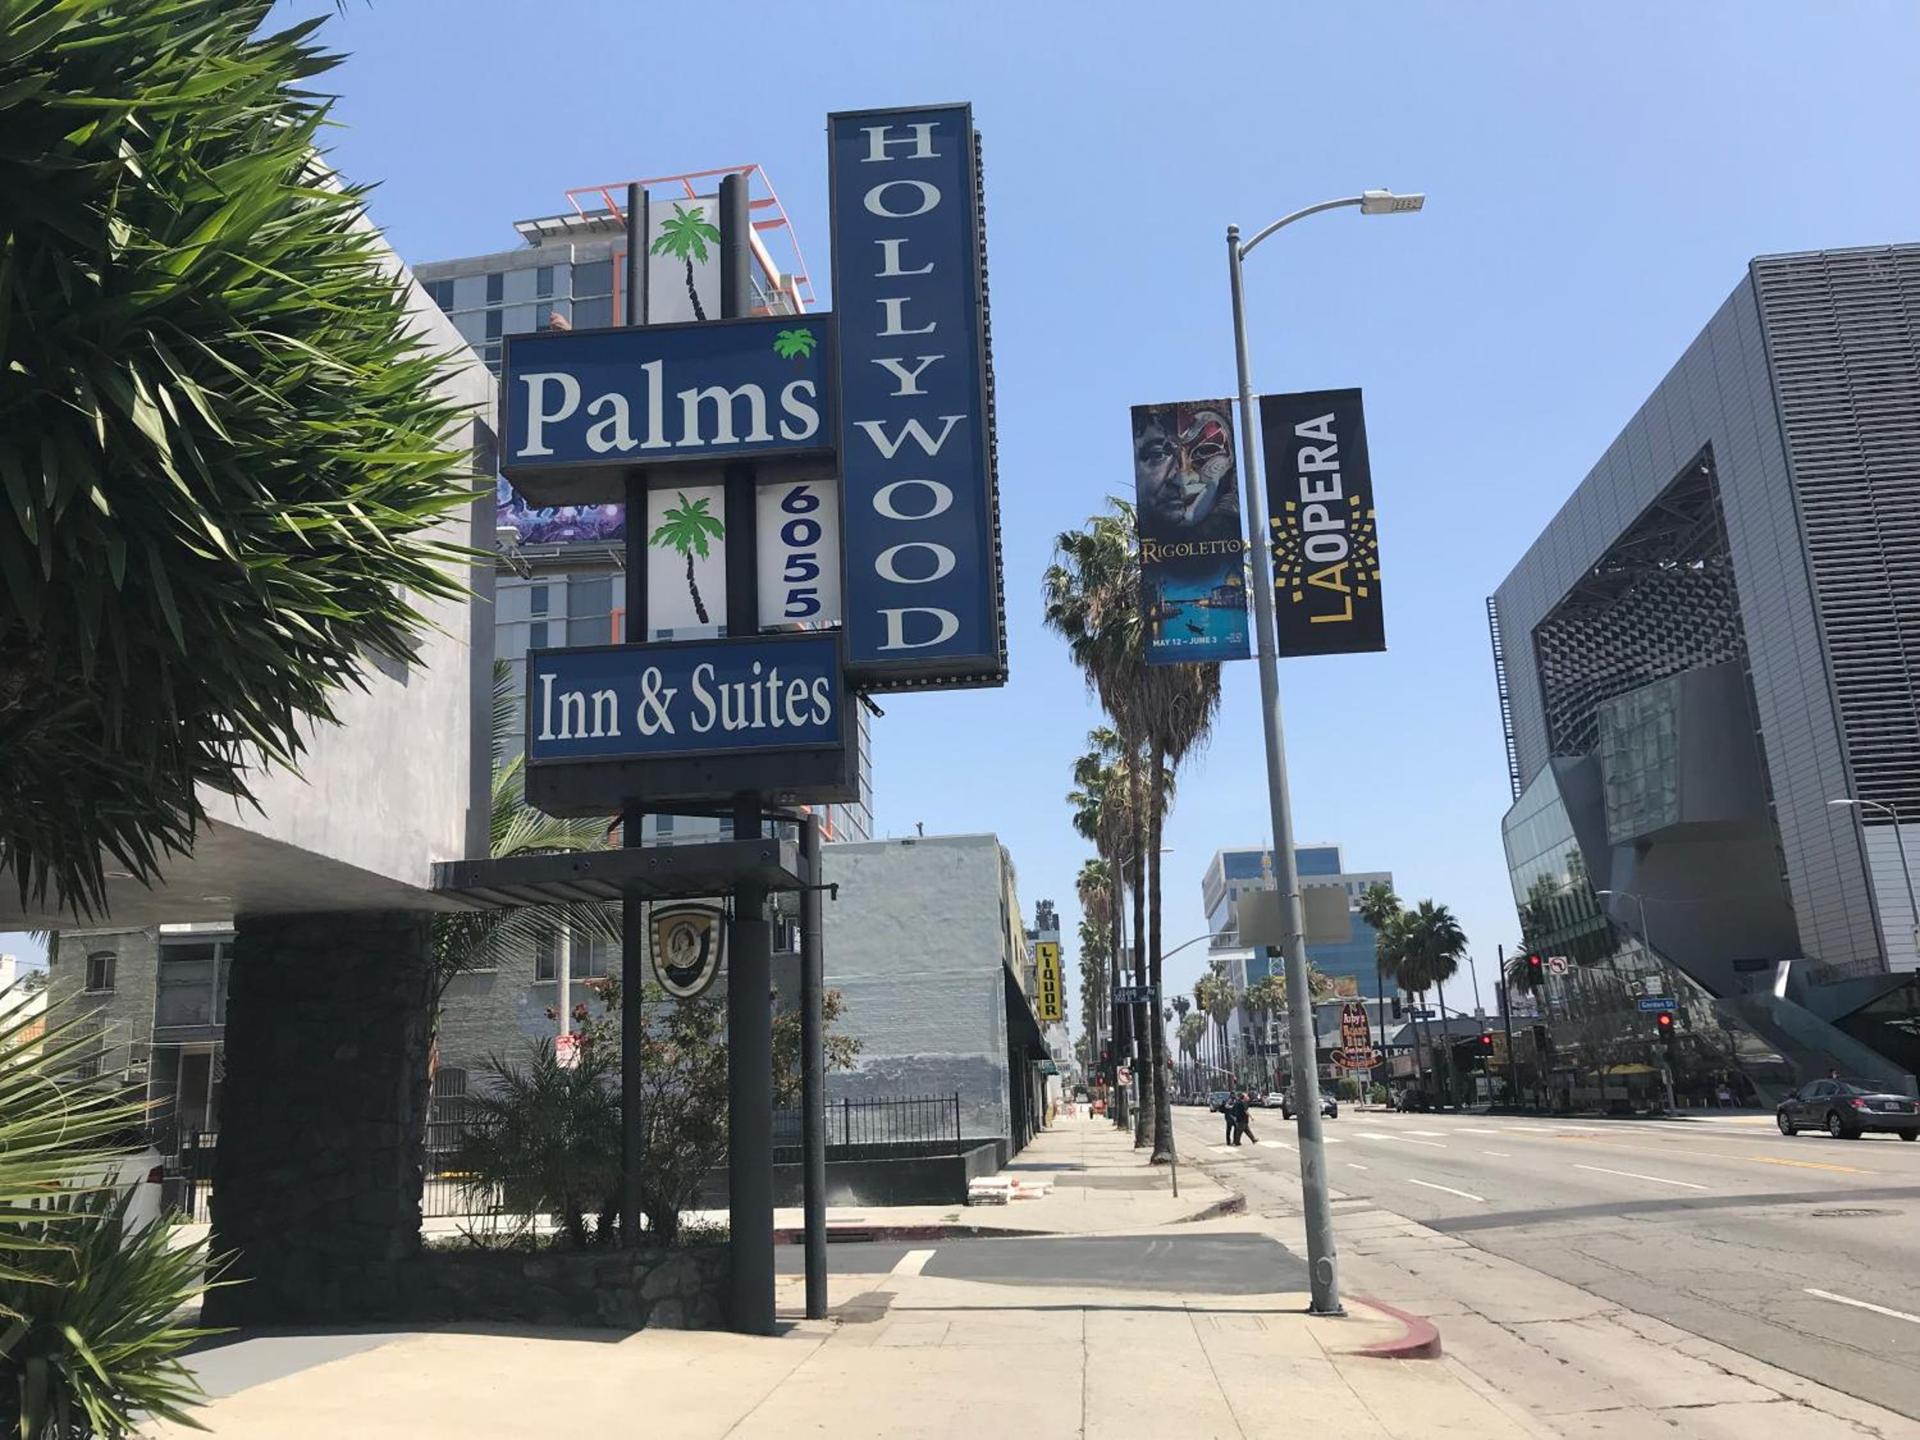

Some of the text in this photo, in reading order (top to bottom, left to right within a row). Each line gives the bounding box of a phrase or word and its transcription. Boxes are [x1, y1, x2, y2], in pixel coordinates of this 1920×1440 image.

[516, 359, 819, 457] Palms
[854, 123, 967, 650] HOLLYWOOD
[780, 485, 822, 618] 6055
[1153, 639, 1170, 647] MAY
[1173, 638, 1182, 646] 12
[1189, 636, 1211, 645] JUNE
[1212, 636, 1217, 644] 3
[538, 661, 831, 741] Inn & Suites
[1042, 947, 1057, 1016] LIQUOR
